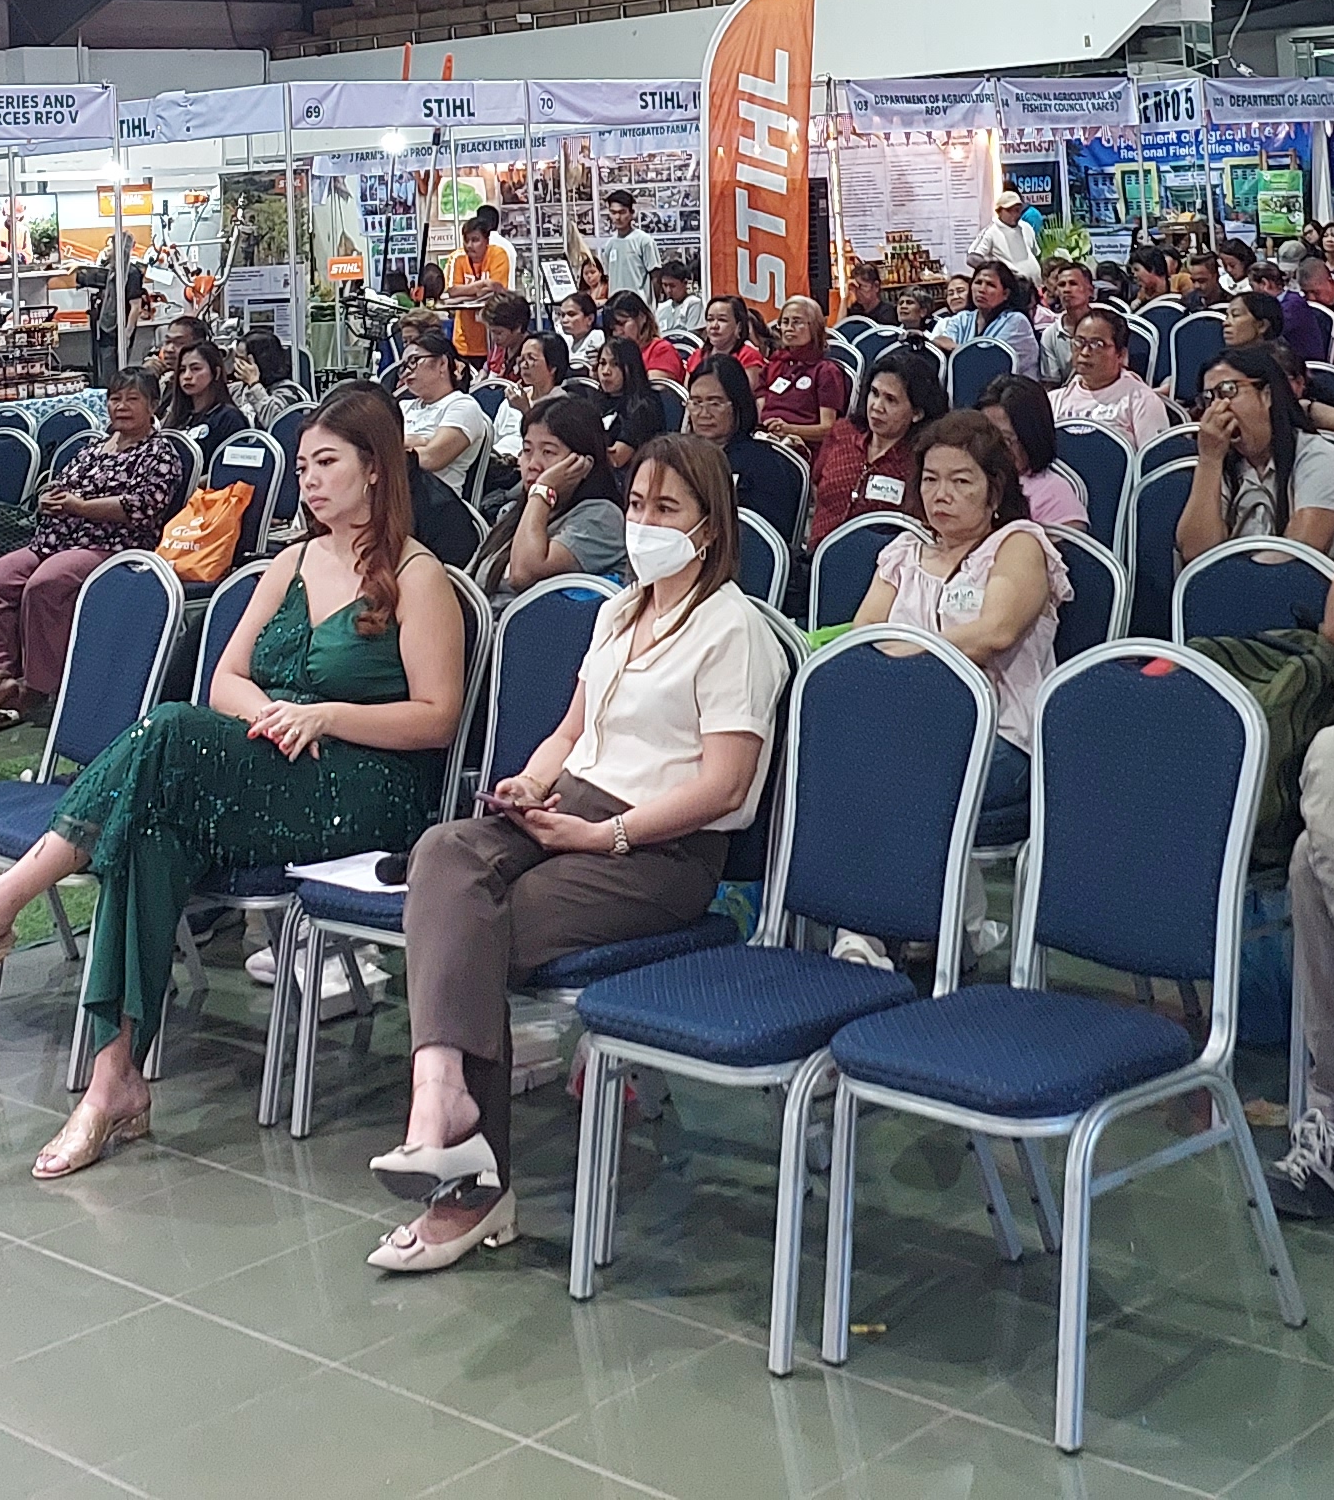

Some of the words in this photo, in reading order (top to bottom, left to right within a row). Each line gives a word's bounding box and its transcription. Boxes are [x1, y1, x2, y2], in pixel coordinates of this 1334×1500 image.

[42, 93, 76, 109] AND
[639, 91, 688, 112] STIHL,
[853, 100, 868, 112] 103
[874, 94, 927, 105] DEPARTMENT
[928, 94, 939, 104] OF
[942, 93, 995, 105] AGRICULTURE
[1016, 92, 1052, 102] REGIONAL
[1053, 91, 1106, 101] AGRICULTURAL
[1108, 90, 1122, 100] AND
[1229, 94, 1286, 108] DEPARTMENT
[1287, 93, 1299, 107] OF
[422, 98, 476, 118] STIHL
[539, 97, 554, 111] 70
[925, 105, 941, 116] RFO
[942, 105, 949, 115] V
[1022, 103, 1052, 113] FISHERY
[1054, 102, 1086, 113] COUNCIL
[1154, 89, 1181, 122] RFO
[1184, 88, 1195, 120] 5
[34, 109, 65, 126] RFO
[65, 109, 79, 125] V
[305, 105, 321, 119] 69
[119, 116, 156, 140] TIHL,
[620, 126, 666, 138] INTEGRATED
[666, 125, 688, 136] FARM
[355, 150, 385, 162] FARM'S
[460, 141, 492, 154] BLACKJ
[1169, 145, 1196, 156] Field
[1235, 141, 1261, 152] No.5
[736, 48, 789, 309] STIHL
[330, 262, 361, 275] STIHL
